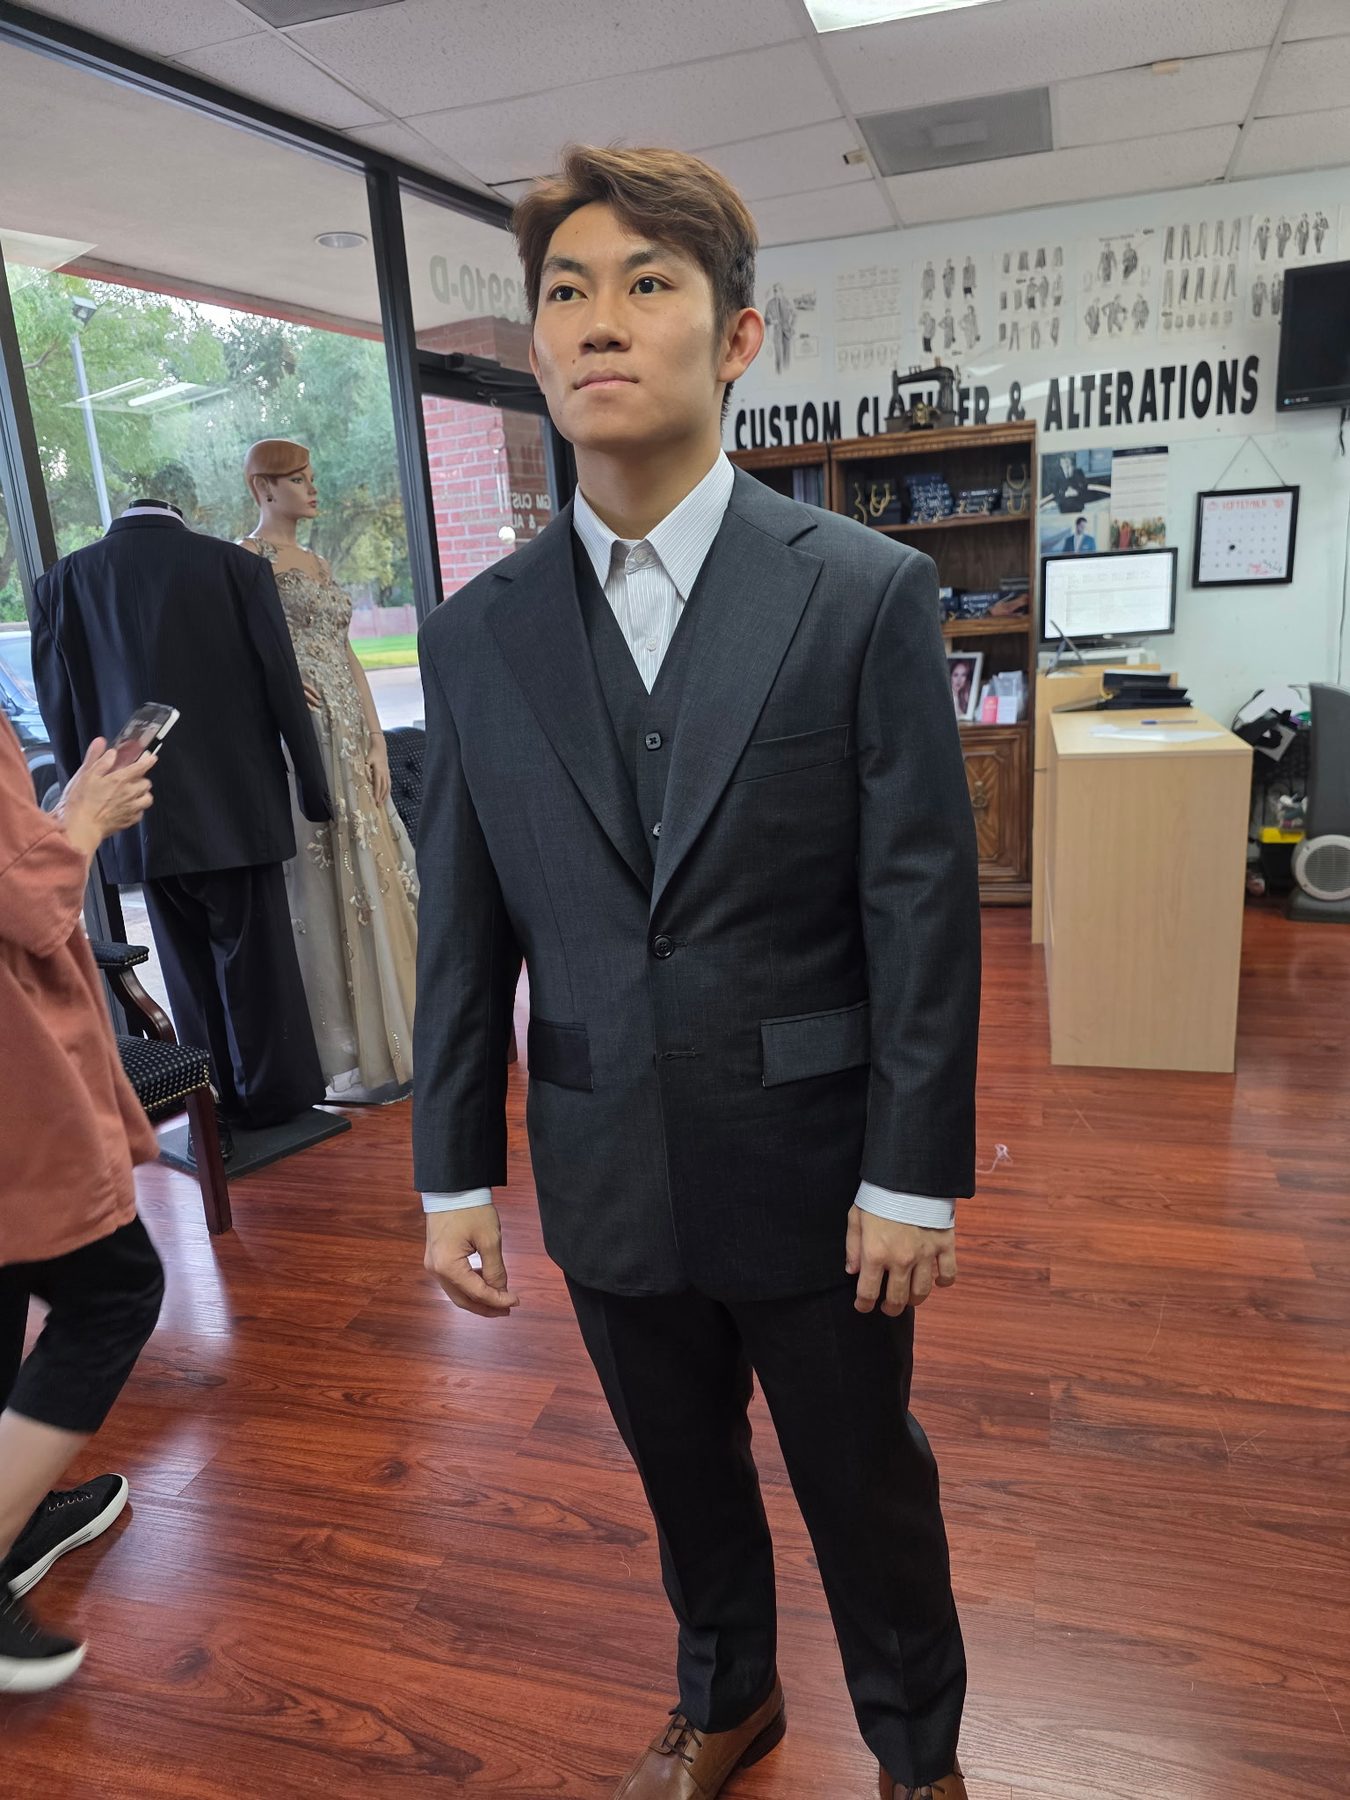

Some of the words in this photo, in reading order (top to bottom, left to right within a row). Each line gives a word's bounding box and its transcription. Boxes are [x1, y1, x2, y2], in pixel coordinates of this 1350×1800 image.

[735, 400, 842, 451] CUSTOM
[1006, 381, 1026, 422] &
[1043, 354, 1260, 432] ALTERATIONS
